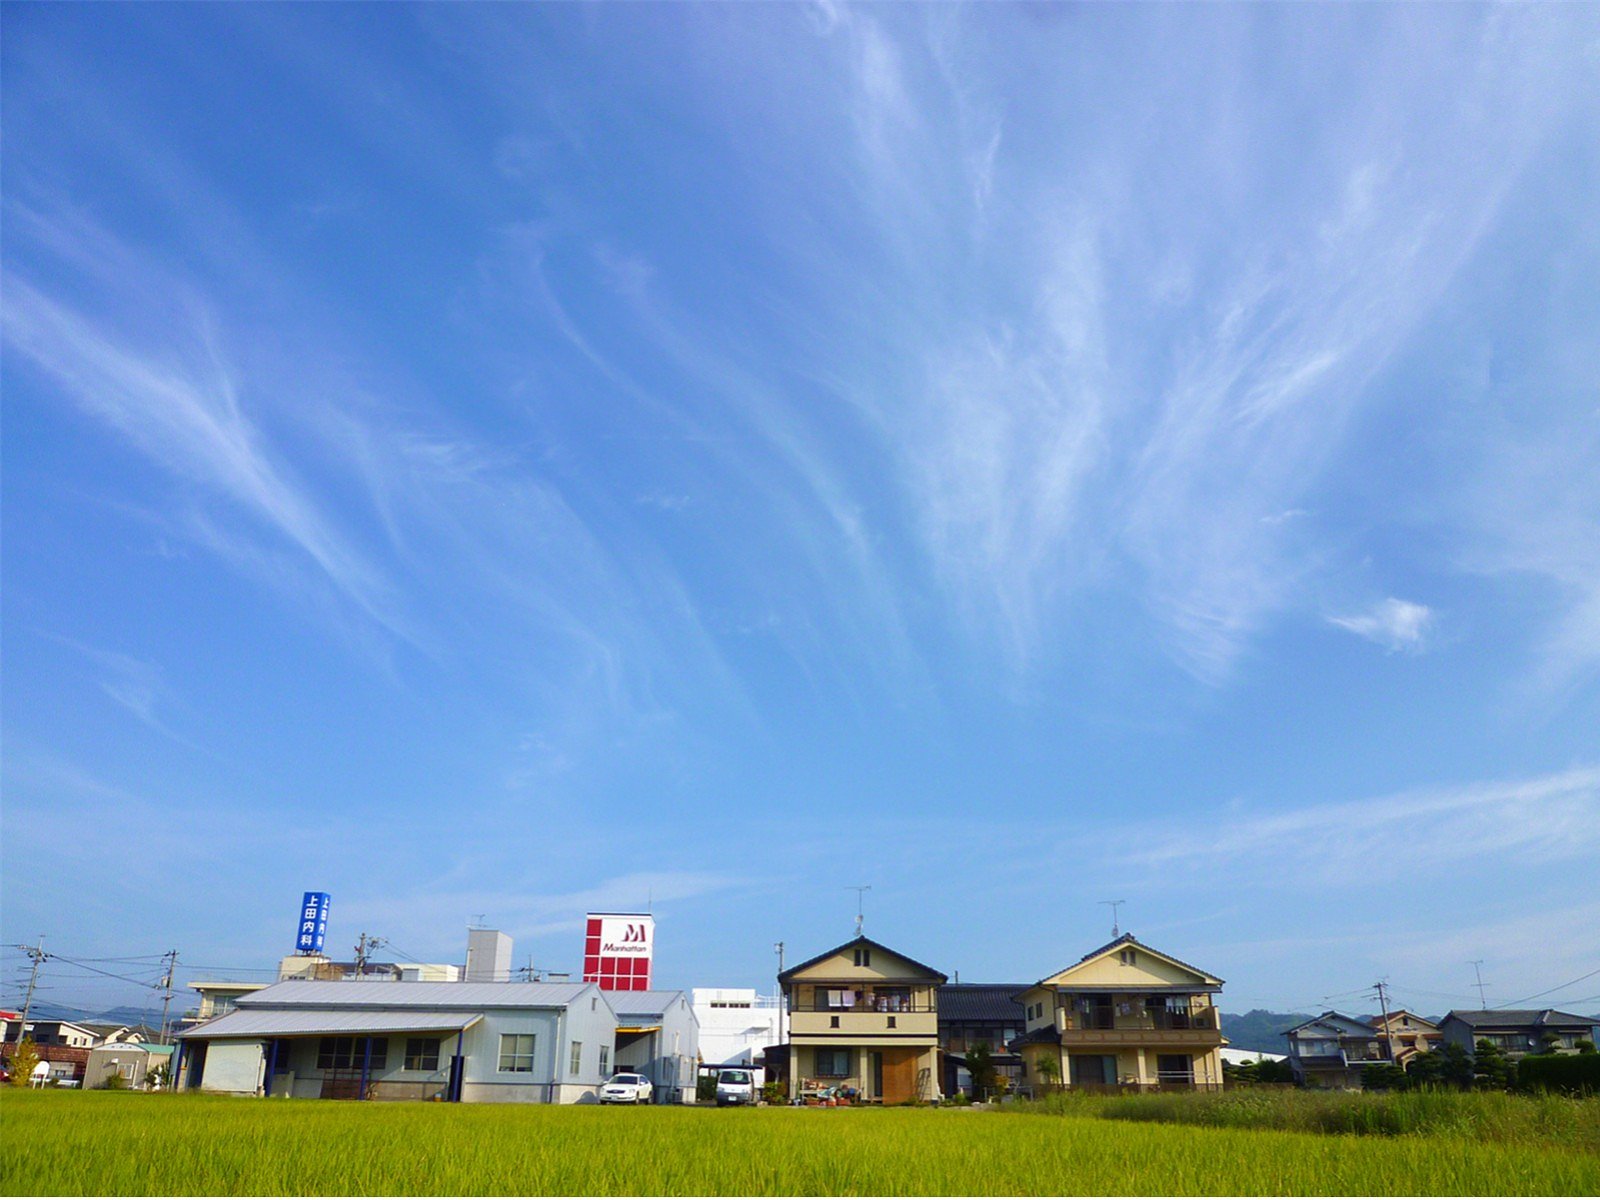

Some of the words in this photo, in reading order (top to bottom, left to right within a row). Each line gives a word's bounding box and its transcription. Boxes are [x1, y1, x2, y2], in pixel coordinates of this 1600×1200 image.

[301, 895, 318, 946] 上田内科
[602, 943, 647, 952] Manhattan
